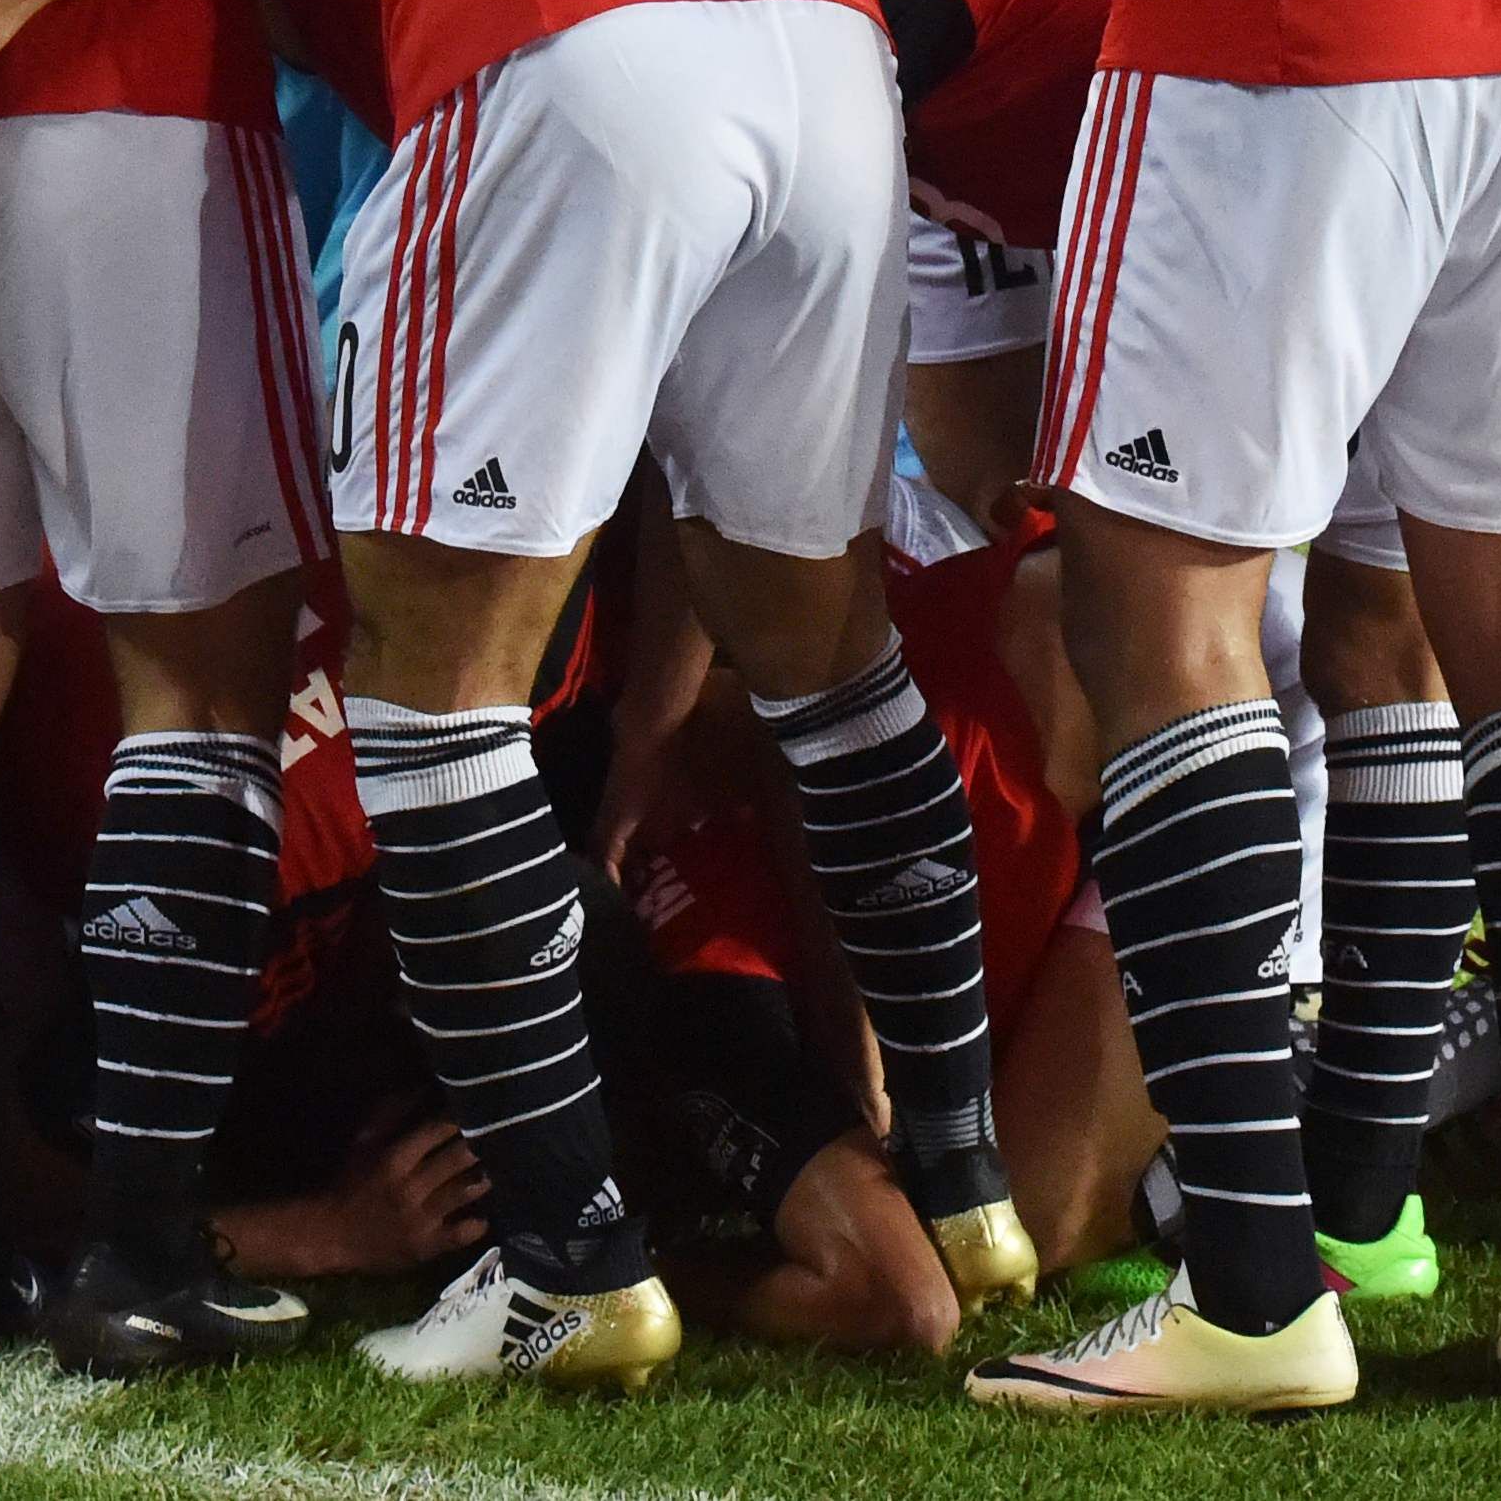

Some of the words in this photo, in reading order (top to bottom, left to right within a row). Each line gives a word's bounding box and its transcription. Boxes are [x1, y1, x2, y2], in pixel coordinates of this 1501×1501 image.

[1105, 451, 1179, 484] adidas
[452, 487, 517, 510] adidas
[83, 921, 197, 949] adidas
[502, 1310, 582, 1382] adidas
